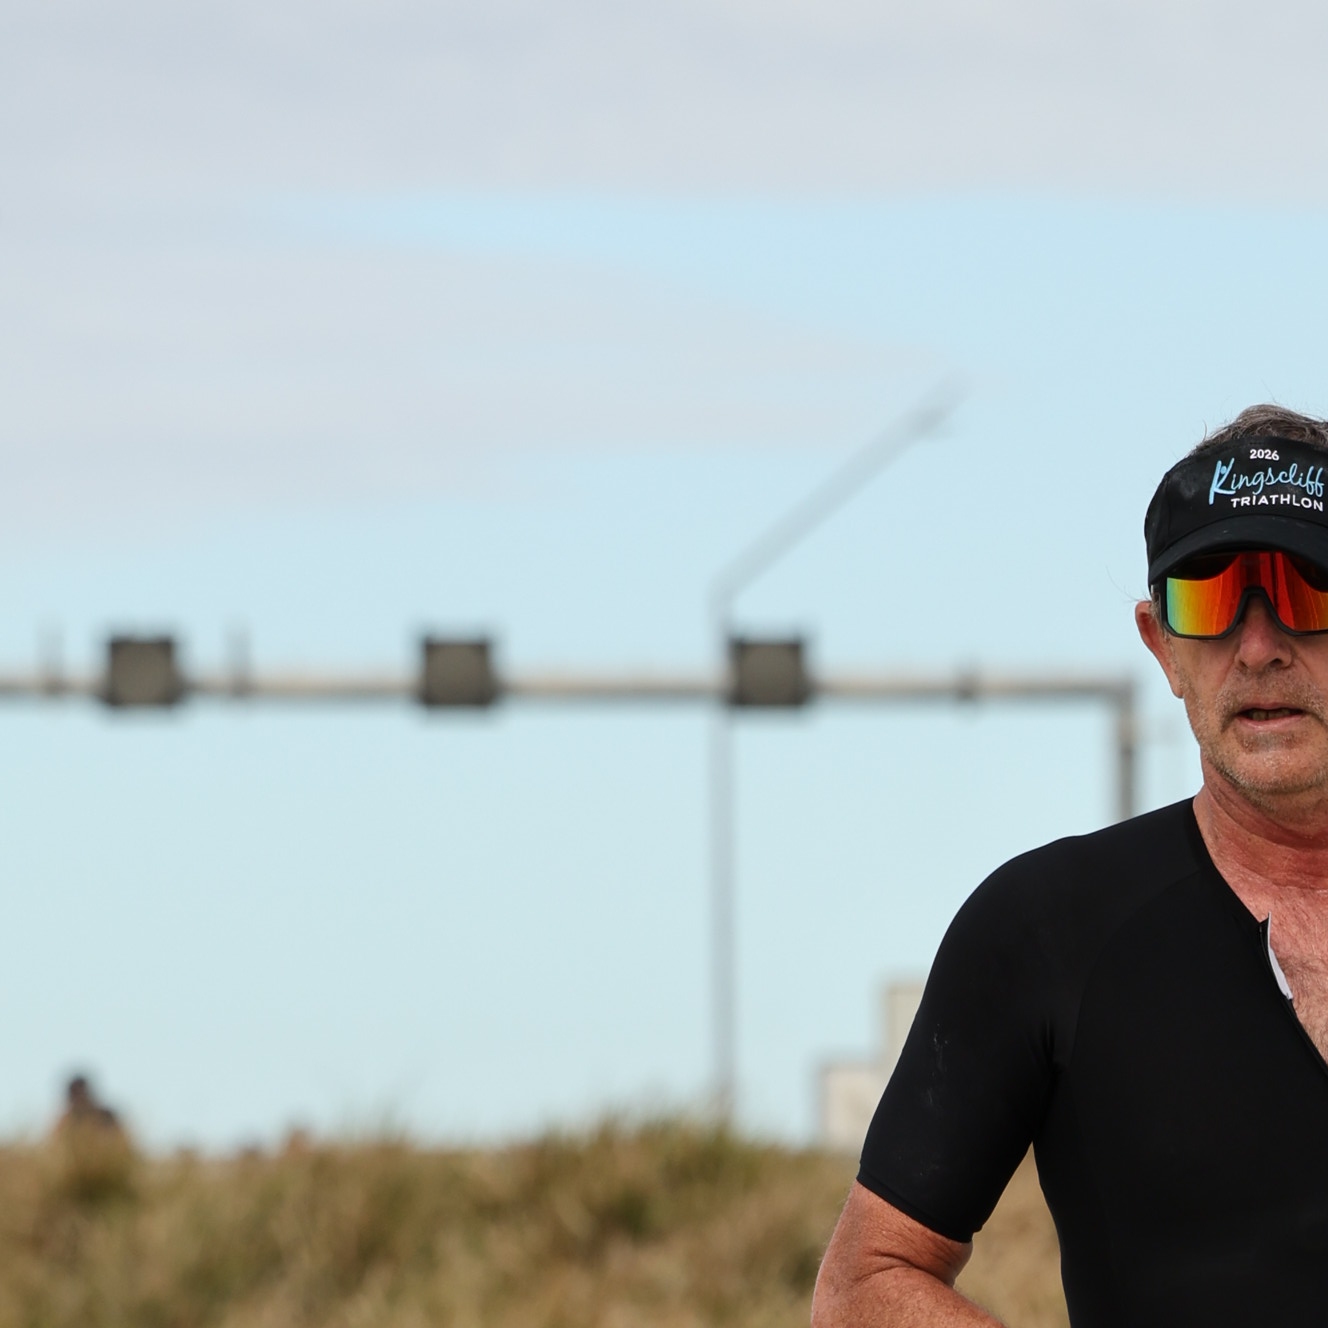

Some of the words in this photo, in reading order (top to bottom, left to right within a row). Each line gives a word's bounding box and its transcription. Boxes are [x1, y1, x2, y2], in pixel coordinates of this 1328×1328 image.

[1249, 449, 1280, 461] 2026
[1208, 457, 1325, 506] Kingscliff
[1230, 494, 1324, 512] TRIATHLON
